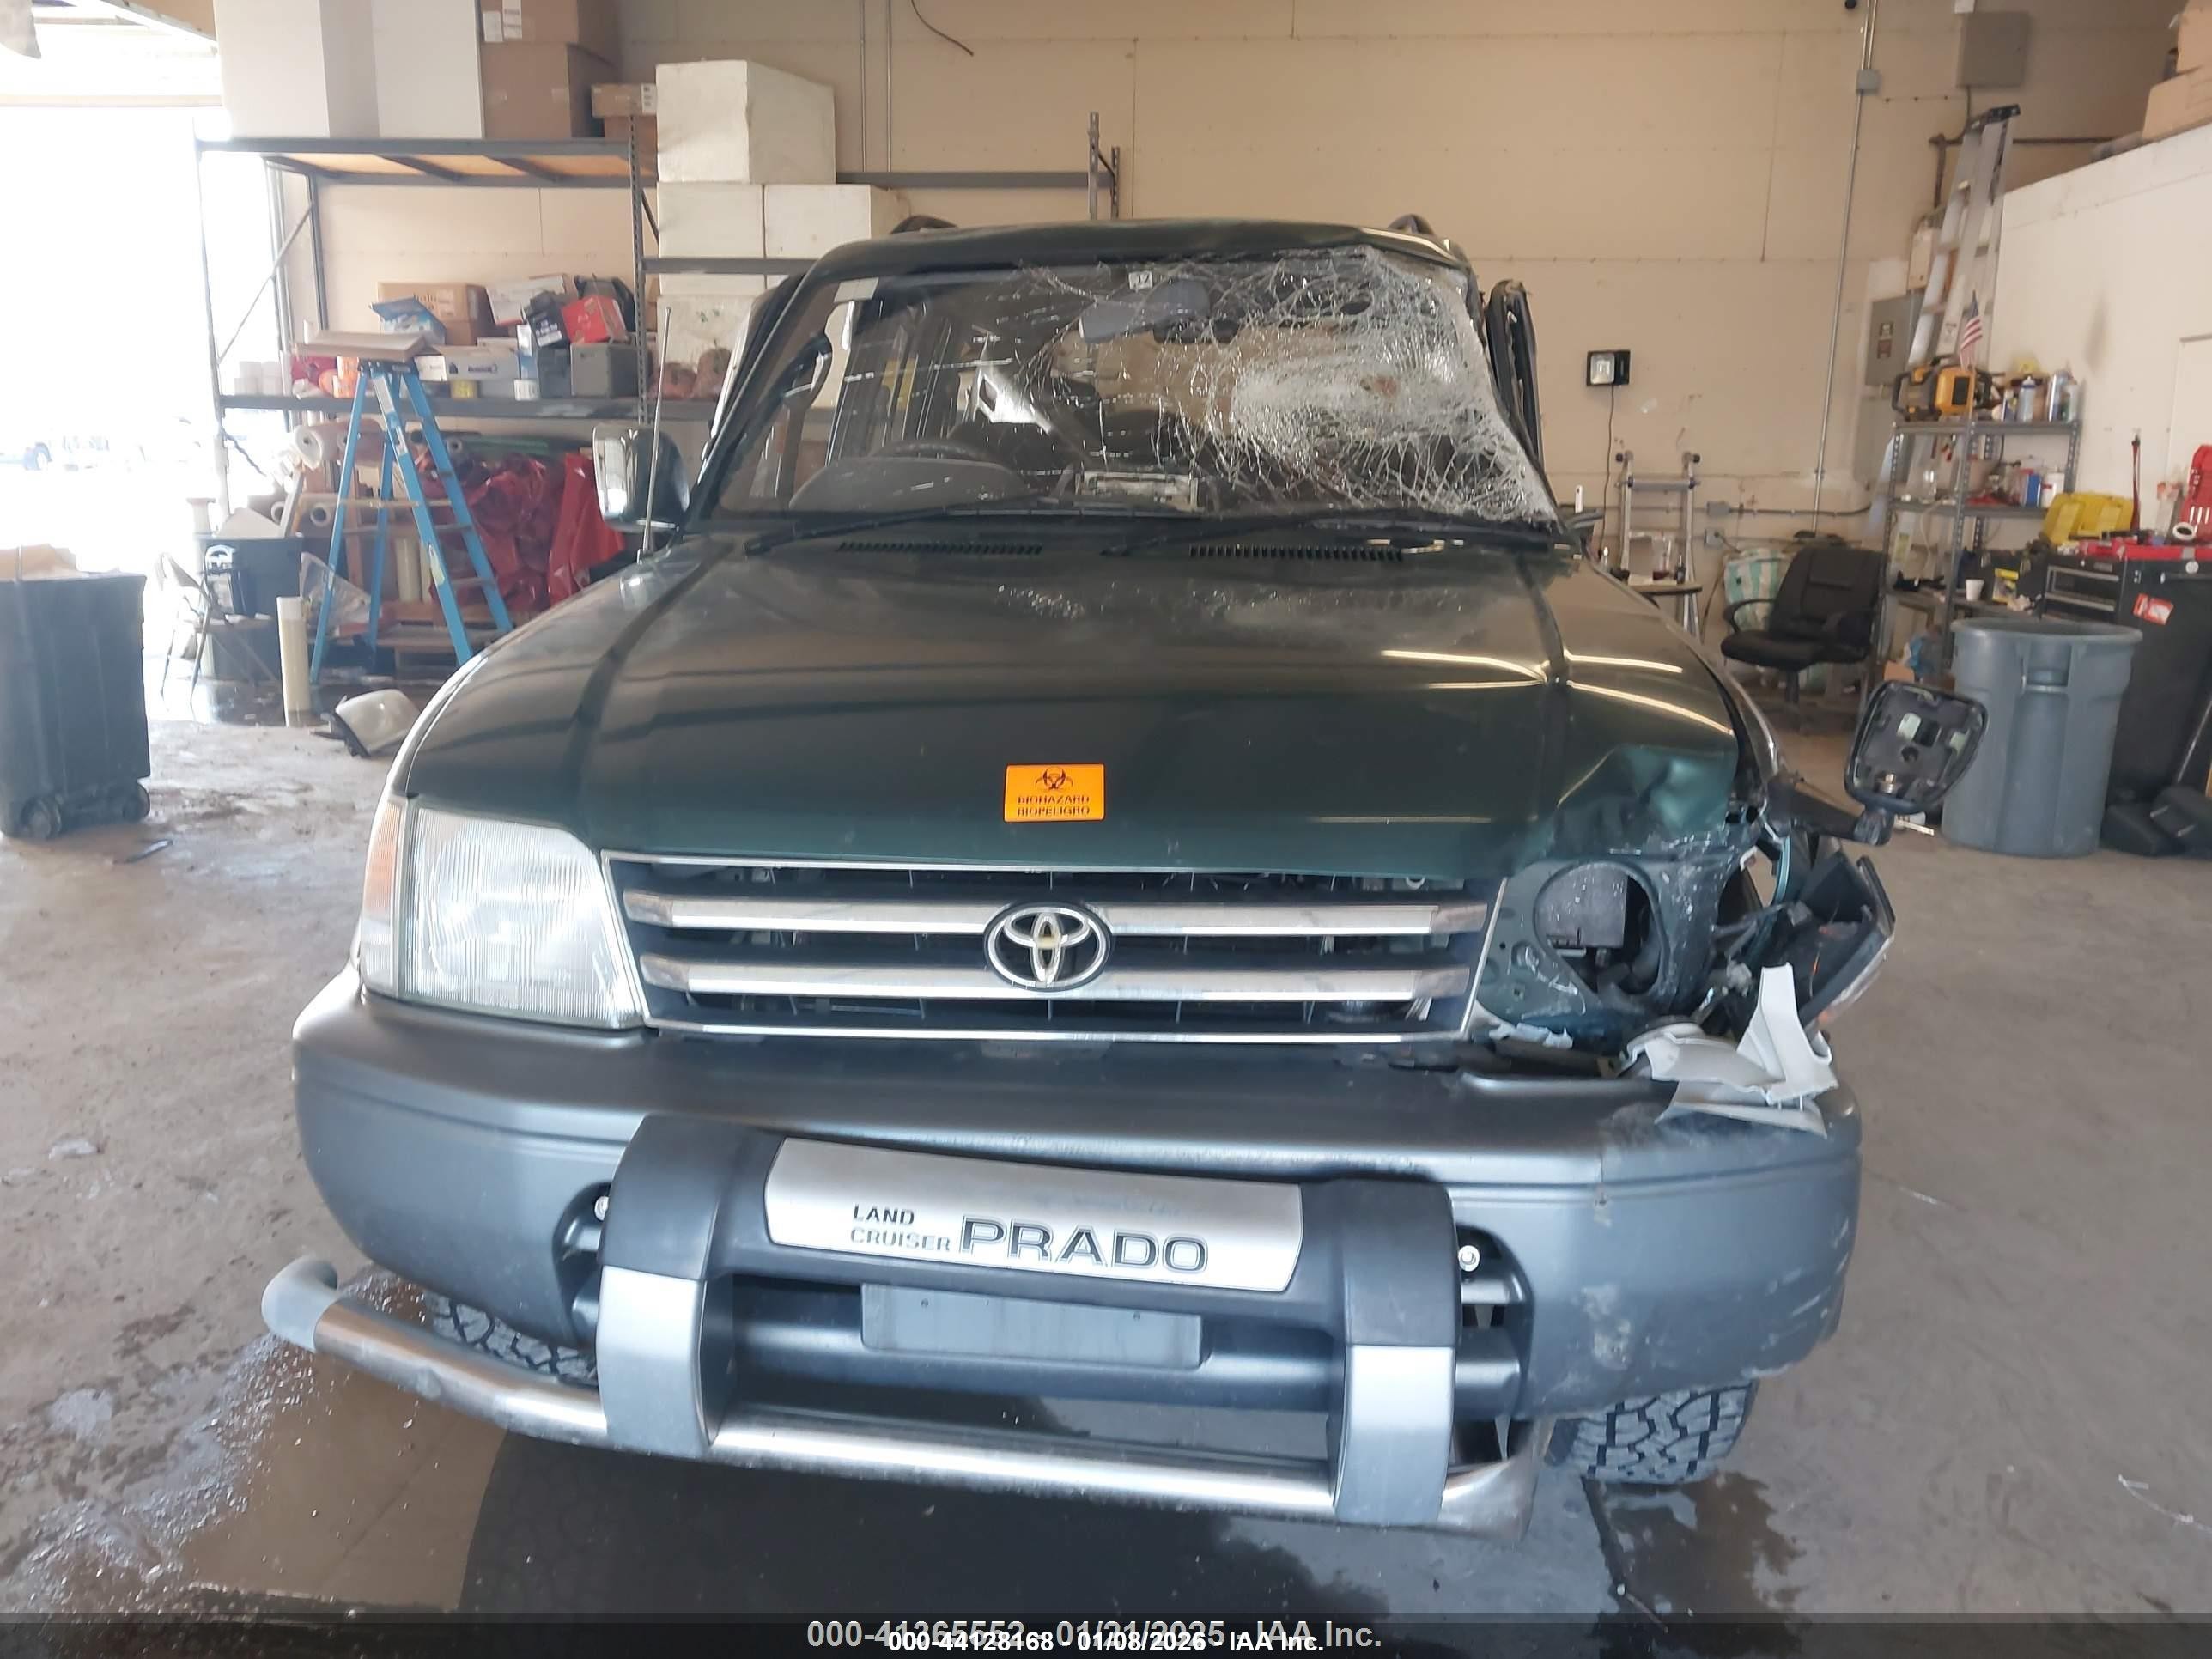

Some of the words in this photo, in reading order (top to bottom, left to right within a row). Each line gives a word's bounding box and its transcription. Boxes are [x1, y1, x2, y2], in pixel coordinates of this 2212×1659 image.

[1017, 794, 1090, 805] BIOHAZARD
[1017, 805, 1090, 817] BIOPELIGRO
[853, 1205, 915, 1225] LAND
[850, 1226, 951, 1251] CRUISER
[958, 1215, 1208, 1273] PRADO
